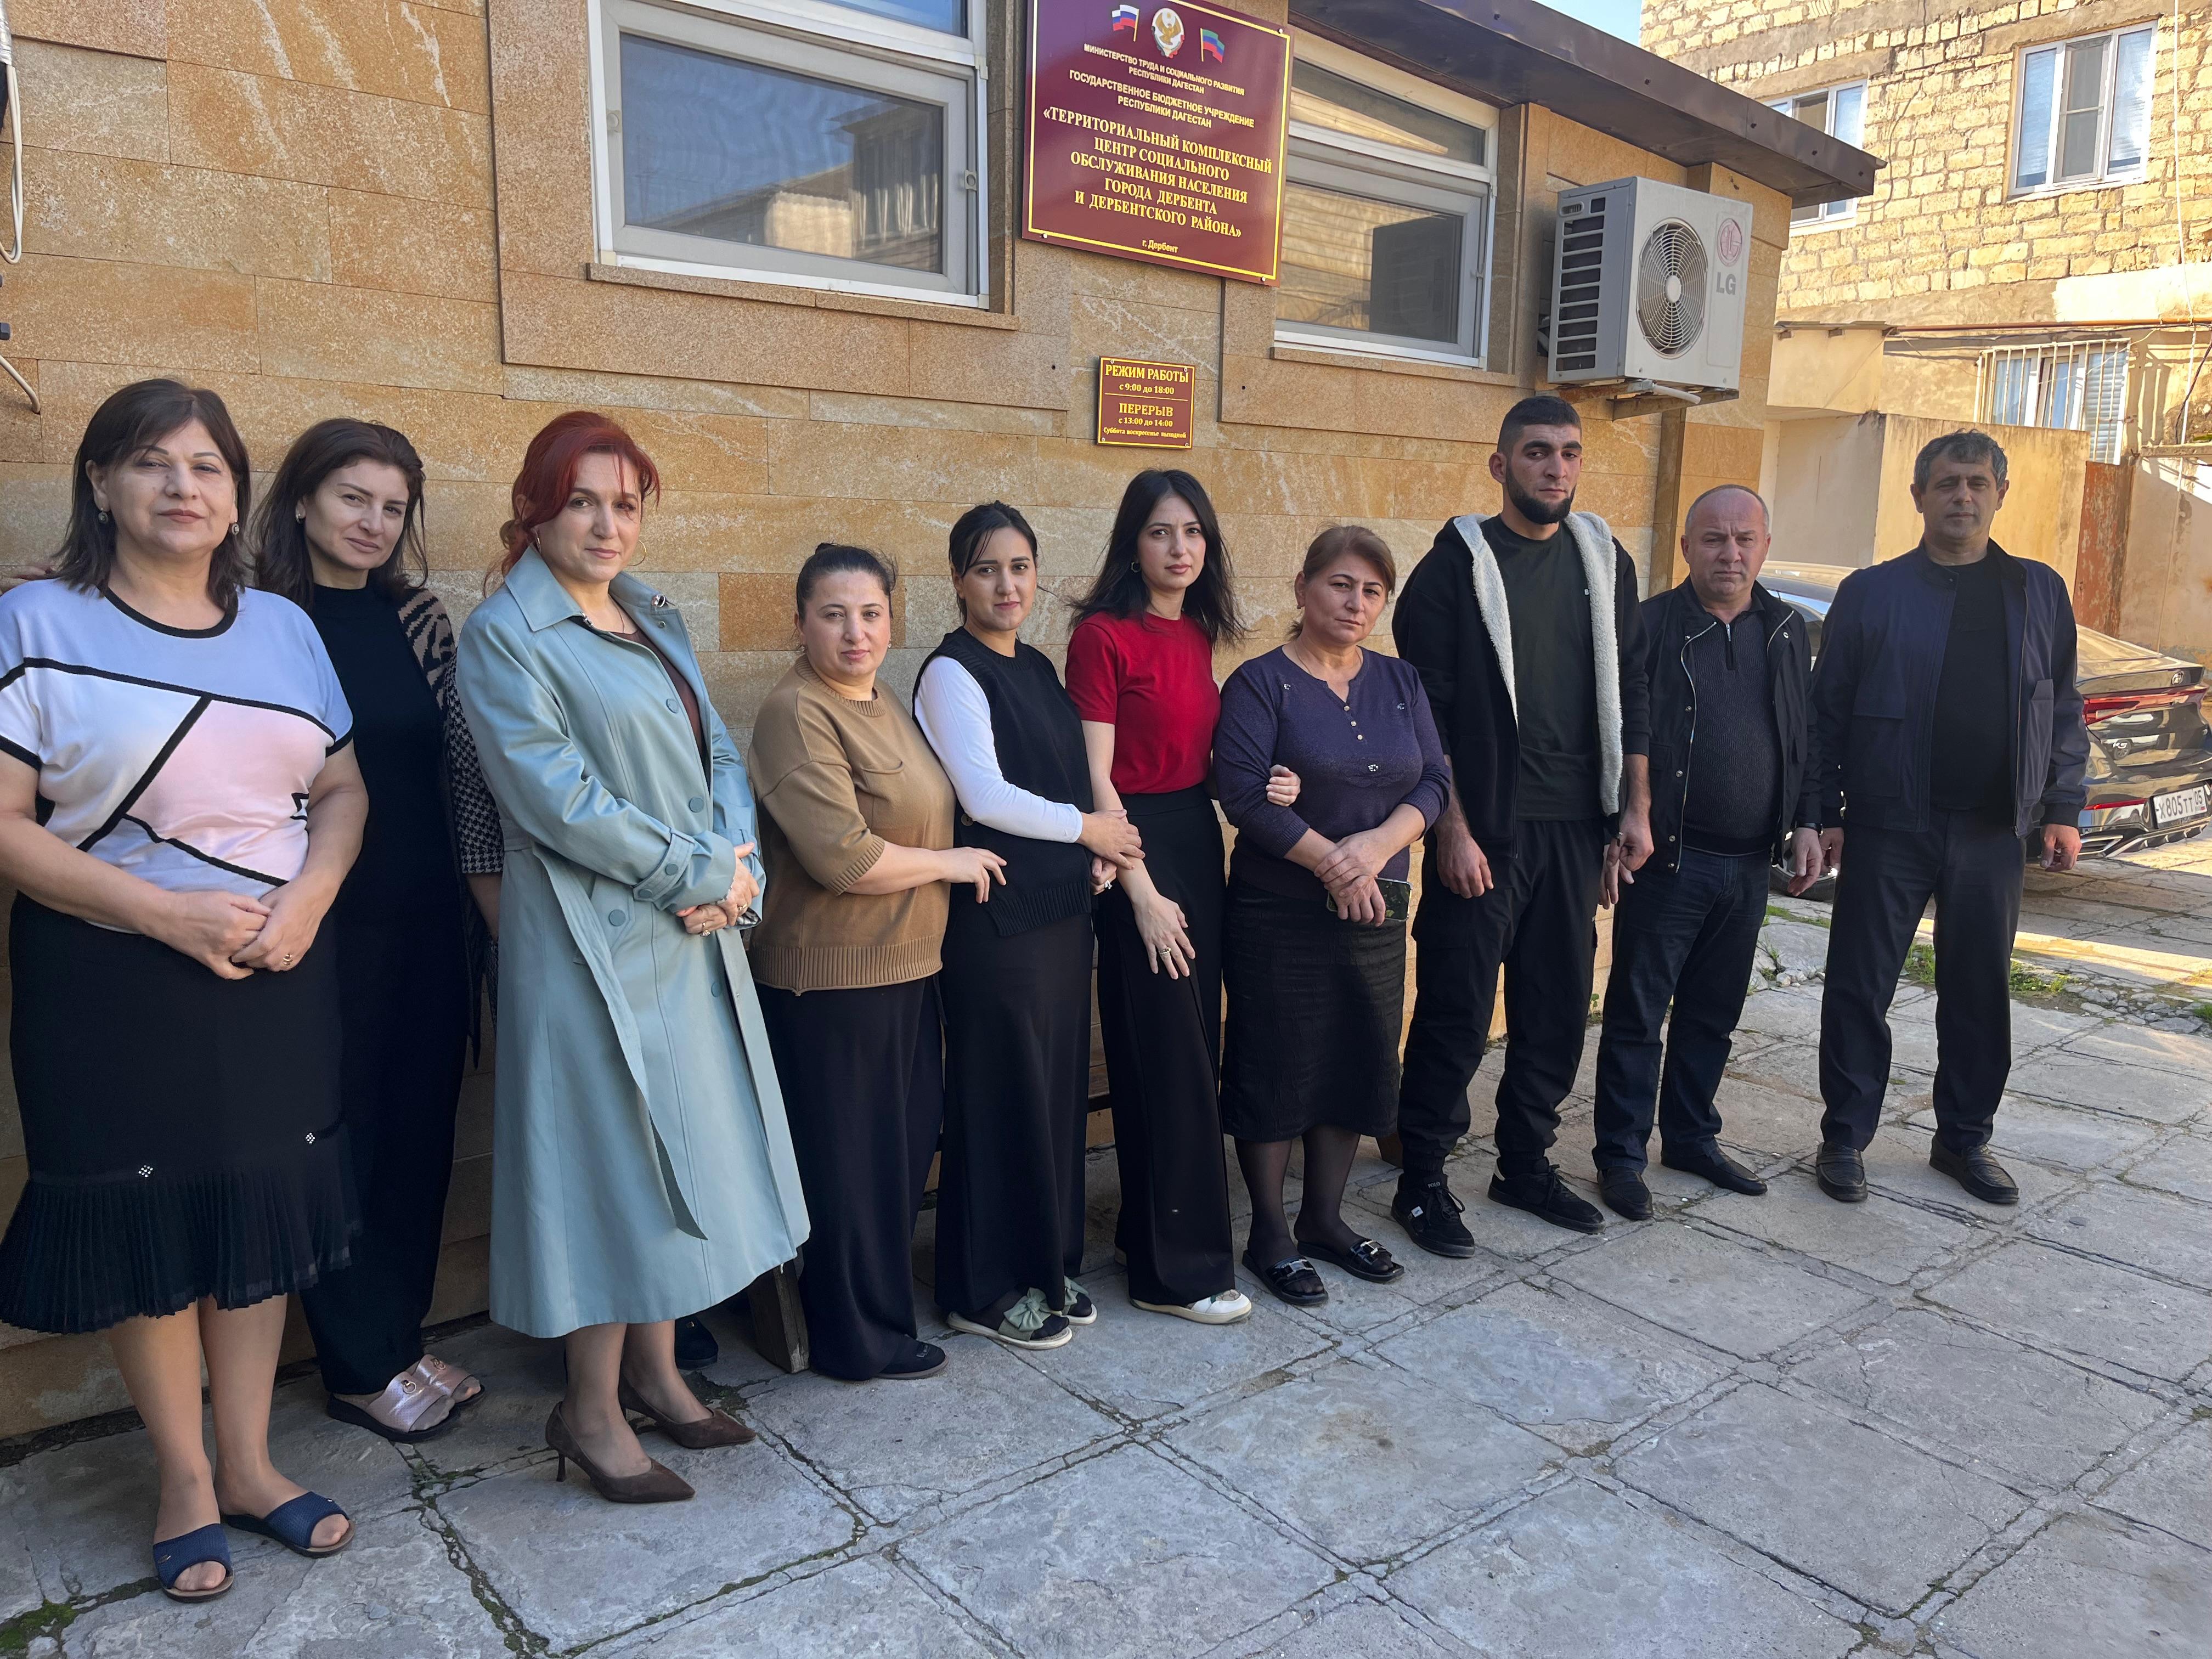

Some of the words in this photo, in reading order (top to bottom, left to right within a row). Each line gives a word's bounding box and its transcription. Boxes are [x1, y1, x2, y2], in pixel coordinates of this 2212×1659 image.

[1084, 43, 1137, 65] МИНИСТЕРСТВО
[1138, 59, 1159, 72] ТРУДА
[1166, 67, 1212, 87] СОЦИАЛЬНОГО
[1213, 81, 1245, 96] РАЗВИТИЯ
[1128, 66, 1171, 84] РЕСПУБЛИКИ
[1172, 79, 1205, 94] ДАГЕСТАН
[1069, 69, 1151, 100] ГОСУДАРСТВЕННОЕ
[1152, 92, 1203, 114] БЮДЖЕТНОЕ
[1204, 106, 1255, 128] УЧРЕЖДЕНИЕ
[1118, 95, 1171, 117] РЕСПУБЛИКИ
[1172, 110, 1212, 128] ДАГЕСТАН
[1043, 106, 1180, 151] «ТЕРРИТОРИАЛЬНЫЙ
[1182, 139, 1272, 174] КОМПЛЕКСНЫЙ
[1094, 137, 1137, 159] ЦЕНТР
[1139, 148, 1229, 181] СОЦИАЛЬНОГО
[1070, 151, 1176, 187] ОБСЛУЖИВАНИЯ
[1178, 176, 1248, 204] НАСЕЛЕНИЯ
[1104, 177, 1153, 201] ГОРОДА
[1156, 190, 1217, 215] ДЕРБЕНТА
[1074, 190, 1085, 205] И
[1088, 194, 1186, 226] ДЕРБЕНТСКОГО
[1191, 216, 1242, 238] РАЙОНА»
[1148, 239, 1178, 253] Дербент
[1716, 272, 1736, 295] LG
[1105, 364, 1146, 379] РЕЖИМ
[1147, 368, 1189, 383] РАБОТЫ
[1125, 383, 1142, 392] 9:00
[1154, 386, 1175, 394] 18:00
[1119, 403, 1173, 417] ПЕРЕРЫВ
[1124, 417, 1143, 425] 13:00
[1103, 427, 1125, 435] Суббота
[2194, 790, 2203, 805] 05
